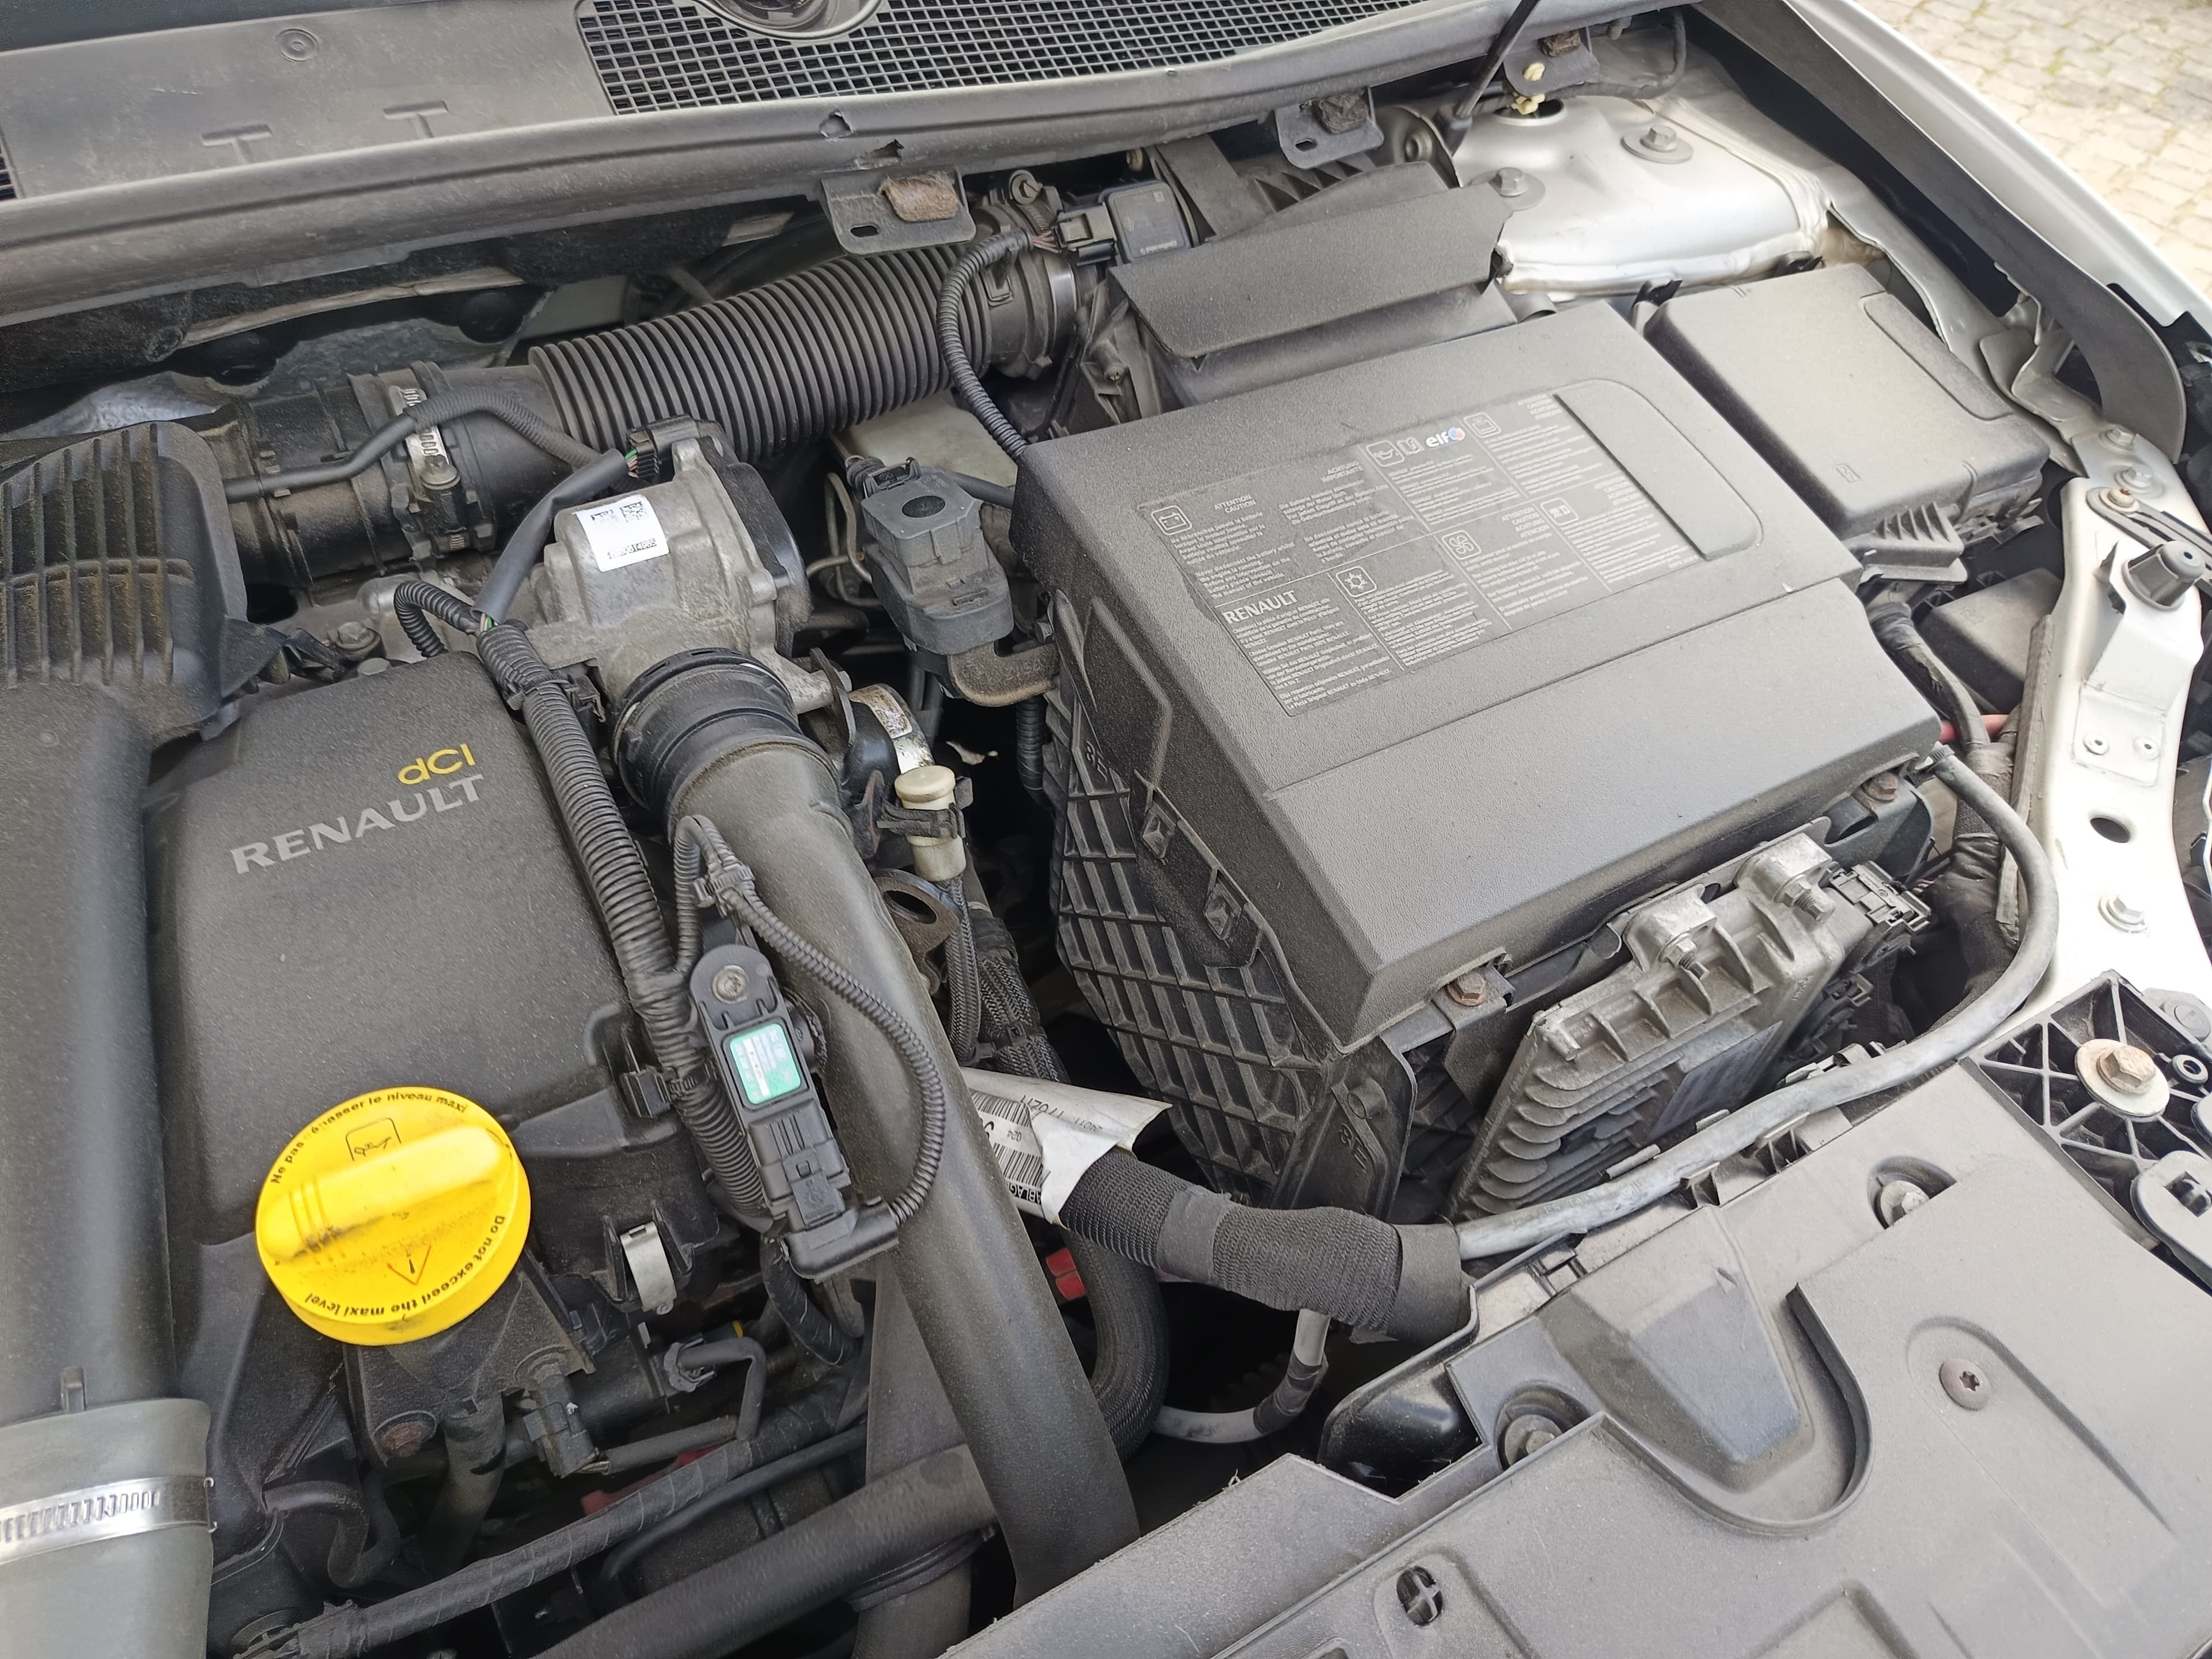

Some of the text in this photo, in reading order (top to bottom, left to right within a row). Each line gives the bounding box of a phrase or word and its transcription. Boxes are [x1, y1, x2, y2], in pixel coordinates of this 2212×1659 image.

[1425, 430, 1451, 449] elf
[1328, 461, 1358, 474] ACHTUNG
[1214, 494, 1251, 509] ATTENTION
[1225, 500, 1255, 512] CAUTION
[1502, 507, 1533, 520] ATTENTION
[1512, 513, 1539, 524] CAUTION
[1222, 589, 1298, 625] RENAULT
[230, 774, 484, 874] RENAULT
[271, 1166, 287, 1185] Ne
[284, 1141, 305, 1164] pas
[368, 1095, 382, 1106] le
[387, 1090, 433, 1103] niveau
[435, 1094, 469, 1114] maxi
[304, 1214, 506, 1317] Do not exceed the maxi level
